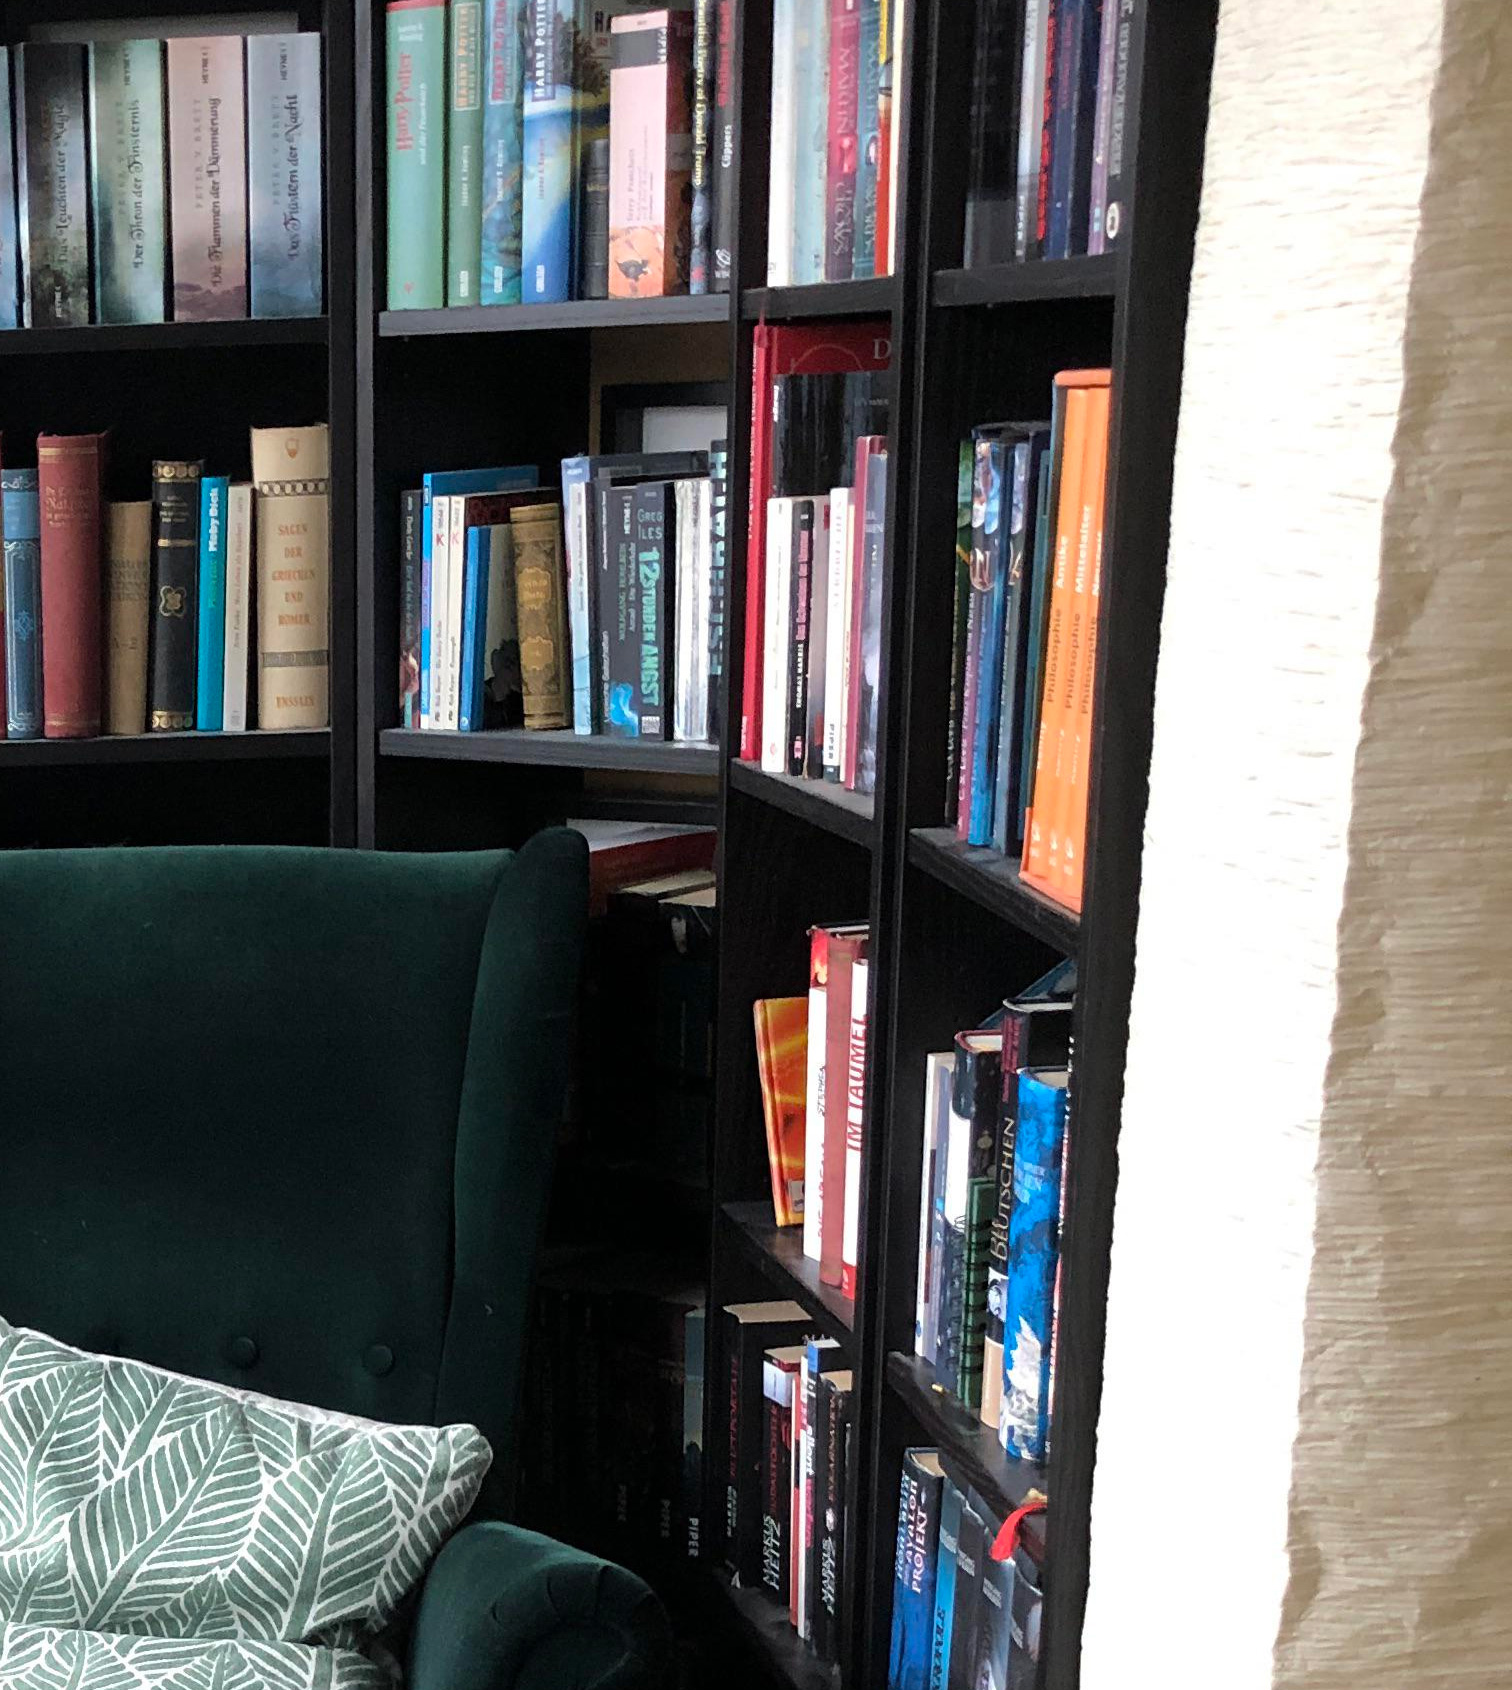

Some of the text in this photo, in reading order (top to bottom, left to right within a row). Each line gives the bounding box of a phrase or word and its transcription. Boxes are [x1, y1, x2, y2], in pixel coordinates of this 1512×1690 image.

[394, 54, 415, 104] Potter
[534, 53, 545, 97] HARRY
[284, 95, 302, 143] Nacht
[396, 109, 413, 150] Harry
[55, 150, 67, 172] der
[286, 146, 298, 167] der
[692, 102, 707, 187] Donald Trump
[127, 99, 145, 269] Der Thron der Finsternis
[205, 98, 222, 287] Die Flammen der Dämmerung
[208, 487, 219, 517] Dick
[637, 508, 664, 522] GREG
[208, 518, 219, 552] Moby
[278, 523, 307, 535] SAGEN
[284, 548, 302, 558] DER
[637, 526, 663, 540] ILES
[1074, 505, 1091, 595] Mittelalter
[1056, 535, 1068, 589] Antike
[639, 547, 659, 707] 12 STUNDEN ANGST
[1046, 608, 1062, 704] Philosophie
[1064, 612, 1081, 710] Philosophie
[1081, 615, 1097, 715] Philosophie
[796, 675, 804, 708] THOMAS
[847, 1014, 868, 1152] IM TAUMEL
[688, 1517, 699, 1557] PIPER
[906, 1480, 918, 1565] AVALON
[912, 1508, 929, 1595] PROJEKT
